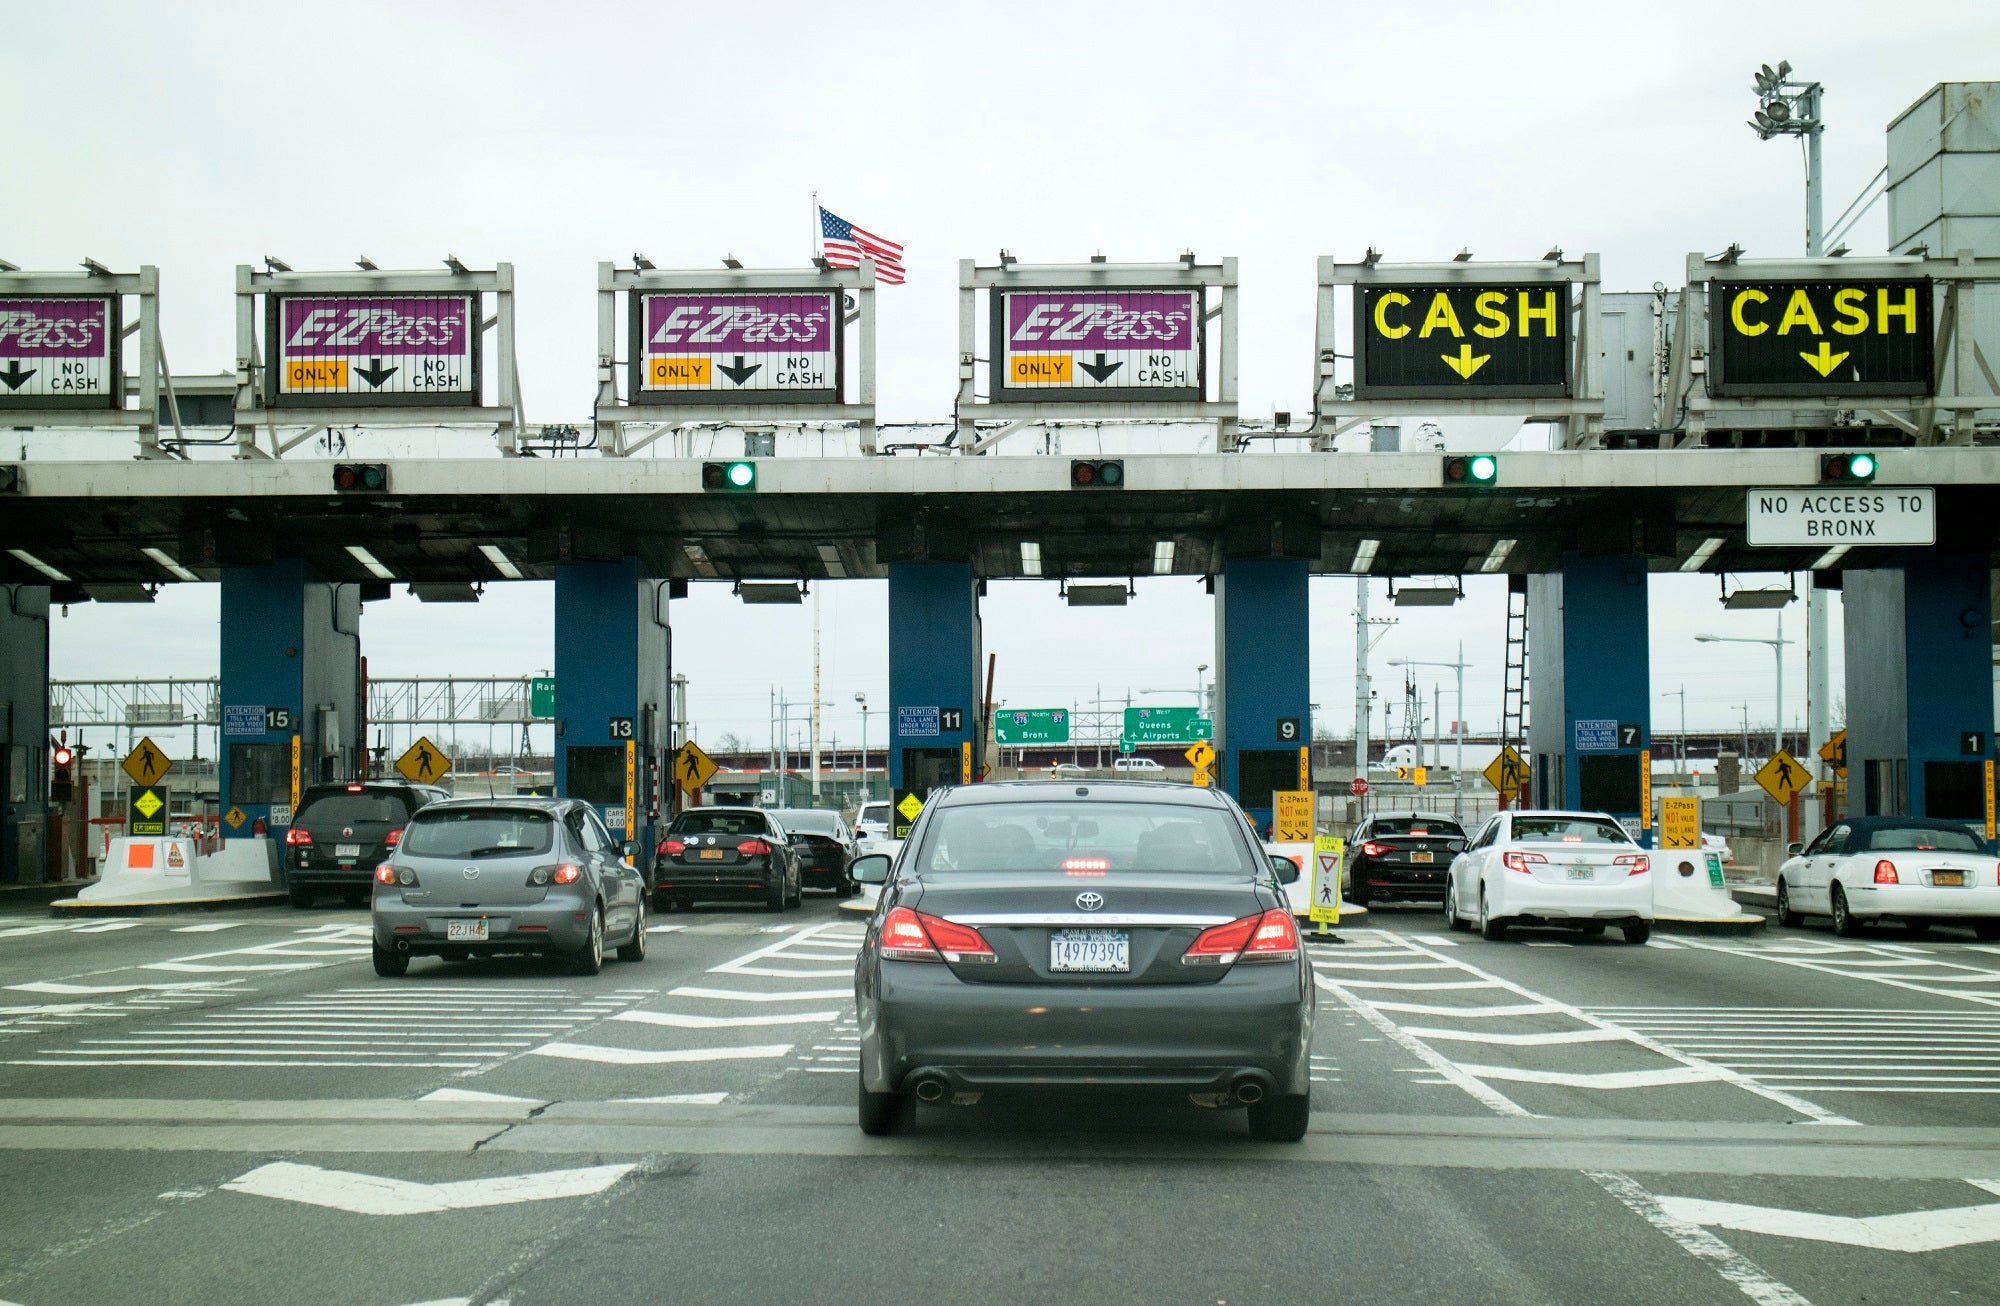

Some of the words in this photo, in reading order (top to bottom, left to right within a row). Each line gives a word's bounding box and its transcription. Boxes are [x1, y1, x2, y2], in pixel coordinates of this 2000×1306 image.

[1374, 291, 1557, 339] CASH
[1731, 288, 1917, 337] CASH
[286, 309, 462, 347] E-ZPass
[650, 306, 826, 343] E-ZPass
[1011, 303, 1188, 341] E-ZPass
[424, 360, 445, 372] NO
[787, 357, 809, 369] NO
[1149, 355, 1171, 367] NO
[62, 363, 84, 374] NO
[294, 368, 340, 381] ONLY
[657, 365, 702, 377] ONLY
[1018, 363, 1064, 375] ONLY
[412, 375, 459, 387] CASH
[776, 372, 823, 384] CASH
[1138, 370, 1185, 382] CASH
[51, 378, 98, 390] CASH
[1760, 497, 1788, 513] NO
[1800, 496, 1884, 513] ACCESS
[1897, 496, 1922, 512] TO
[1807, 520, 1875, 536] BRONX
[266, 711, 289, 727] 15
[942, 712, 960, 728] 11
[1016, 716, 1027, 724] 278
[1139, 721, 1171, 729] Queens
[610, 720, 632, 736] 13
[1282, 722, 1295, 738] 9
[1022, 731, 1049, 739] Bronx
[1143, 732, 1180, 741] Airports
[1624, 728, 1636, 744] 7
[1968, 735, 1978, 752] 1
[293, 746, 299, 760] DO
[628, 751, 634, 765] DO
[1643, 752, 1649, 764] DO
[964, 753, 970, 767] DO
[1301, 757, 1307, 771] DO
[1195, 773, 1206, 781] 30
[1351, 783, 1368, 791] STOP
[1279, 806, 1294, 817] NOT
[1665, 812, 1679, 823] NOT
[1280, 820, 1293, 828] THIS
[1295, 820, 1309, 828] LANE
[1055, 942, 1123, 962] T497939C
